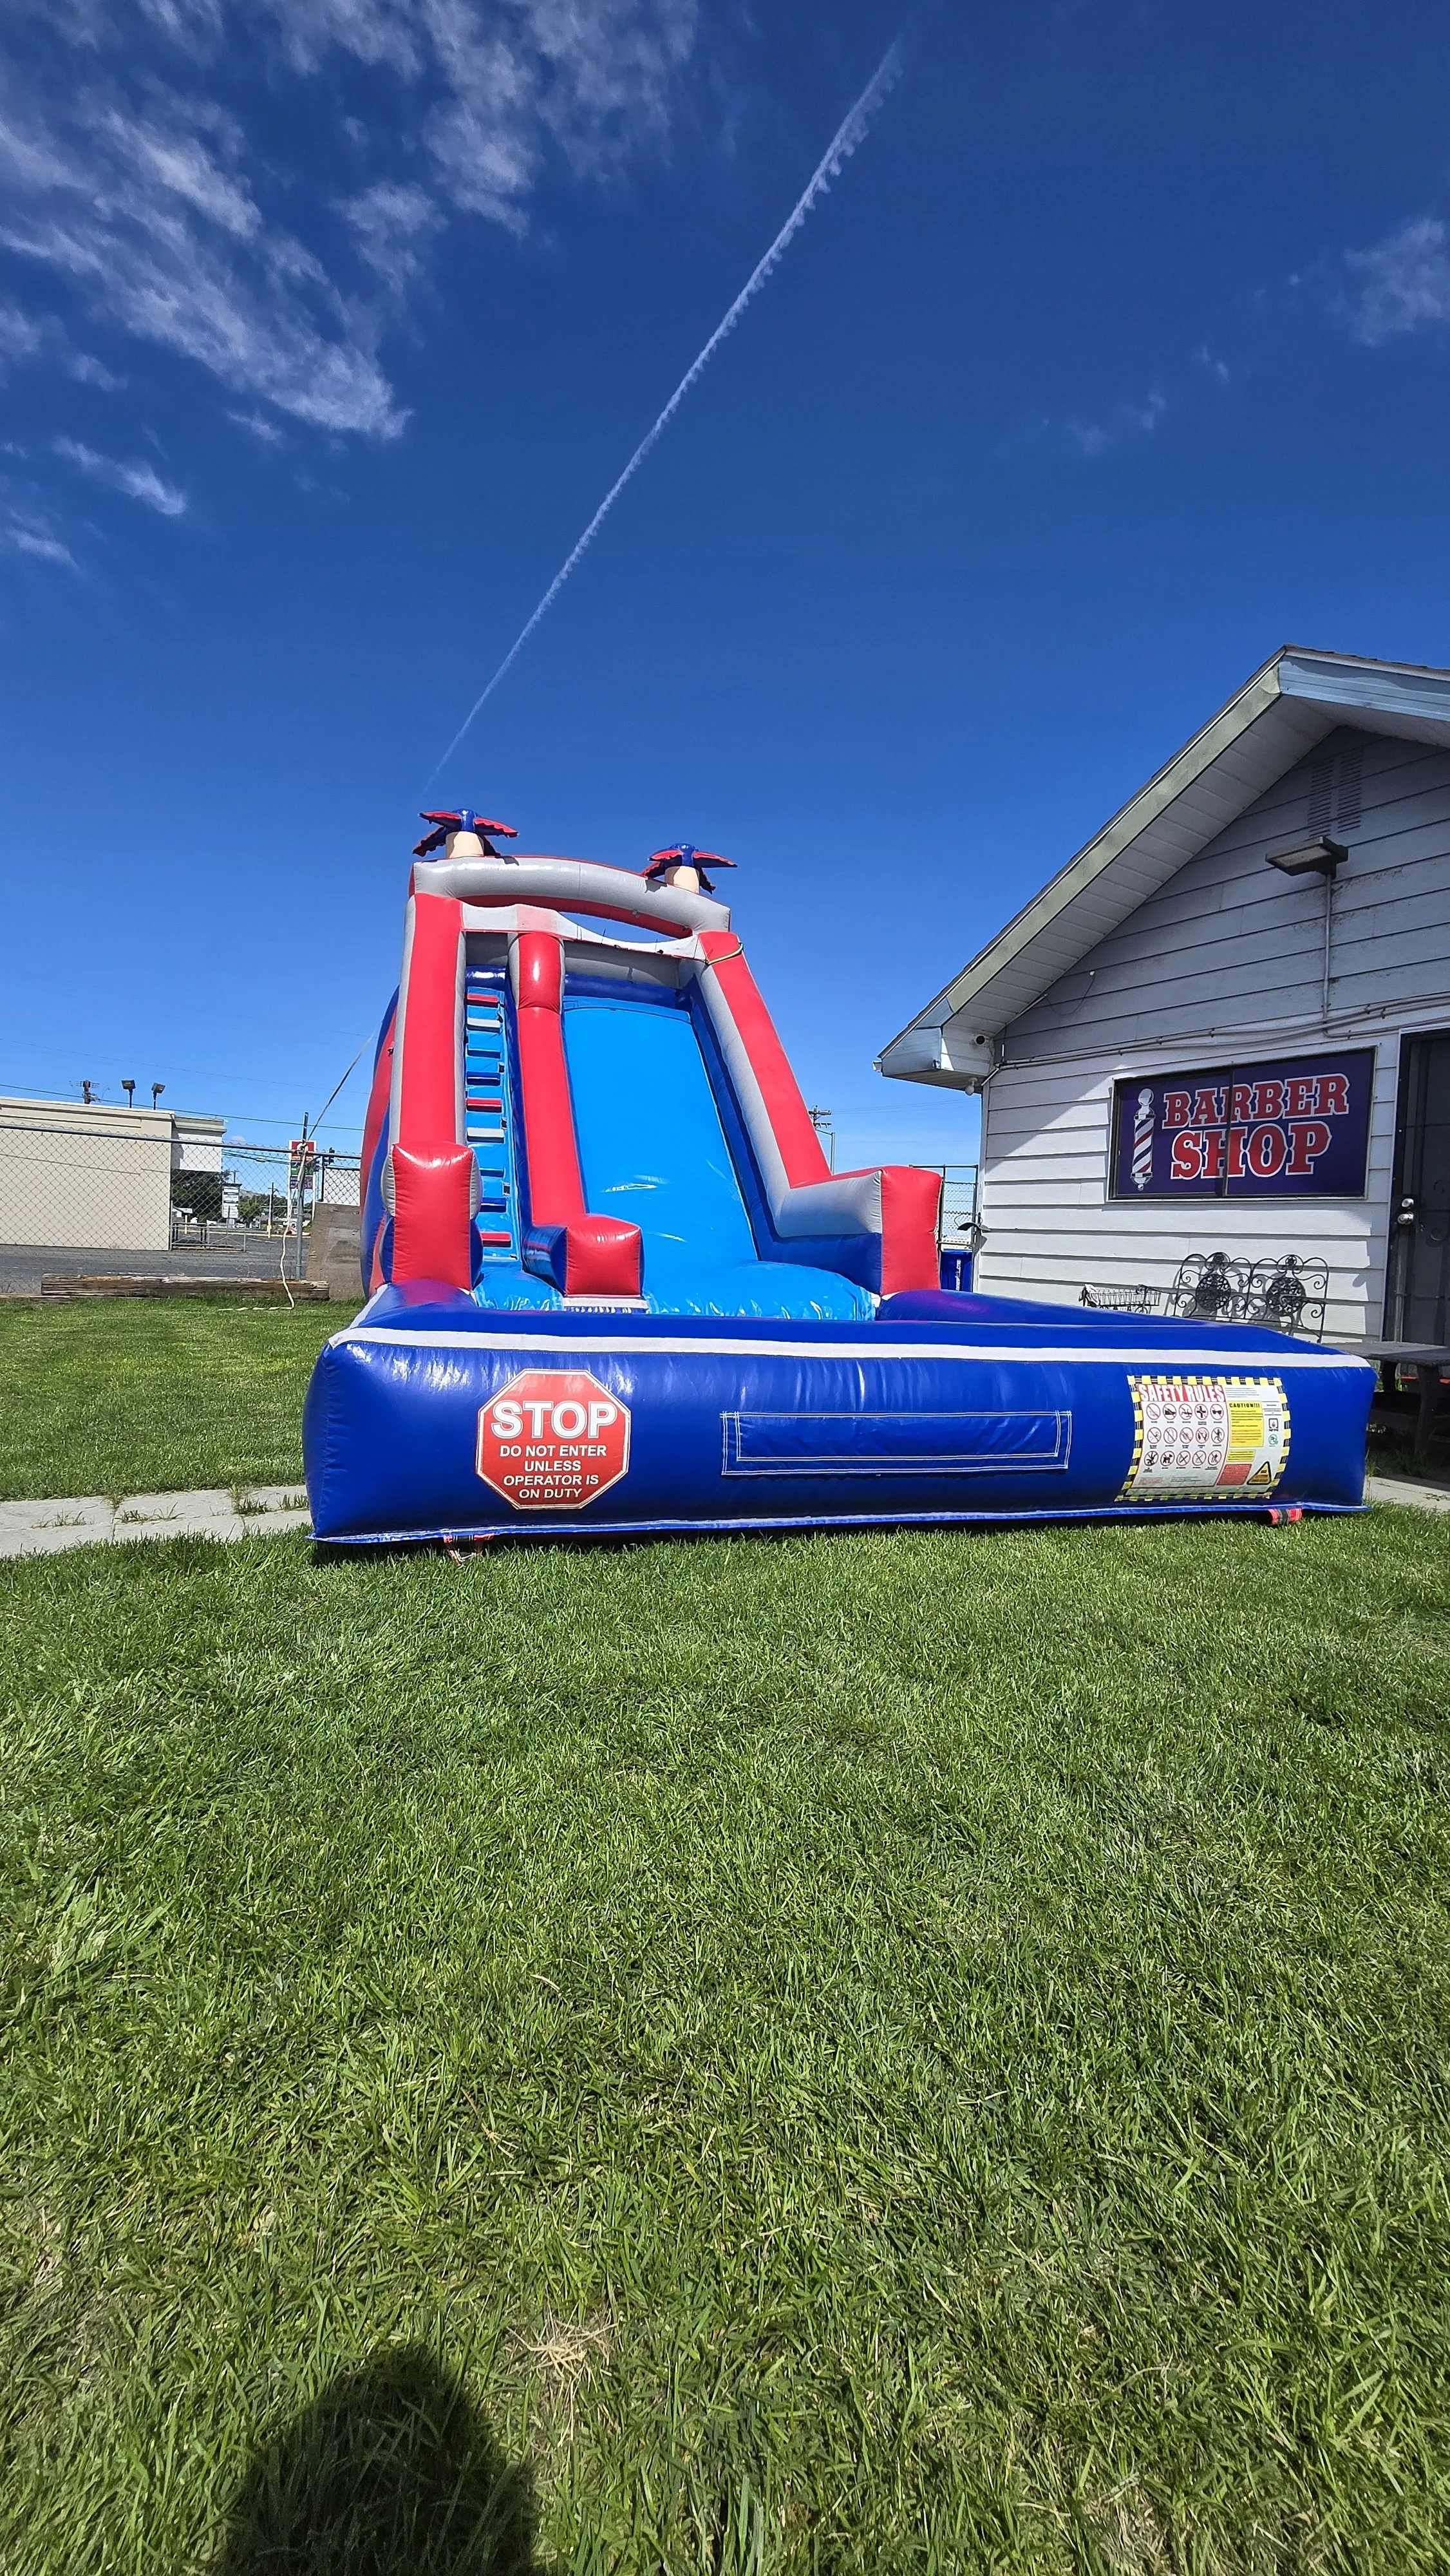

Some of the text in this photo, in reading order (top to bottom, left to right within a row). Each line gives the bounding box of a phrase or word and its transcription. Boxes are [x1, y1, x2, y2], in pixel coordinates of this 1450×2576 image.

[1162, 1073, 1350, 1129] BARBER
[1170, 1121, 1333, 1180] SHOP
[1138, 1384, 1183, 1402] SAFETY
[1187, 1385, 1225, 1402] RULES
[491, 1400, 618, 1439] STOP
[500, 1444, 607, 1457] DO NOT ENTER
[524, 1460, 581, 1472] UNLESS
[503, 1474, 599, 1486] OPERATOR IS
[518, 1488, 583, 1499] ON DUTY
